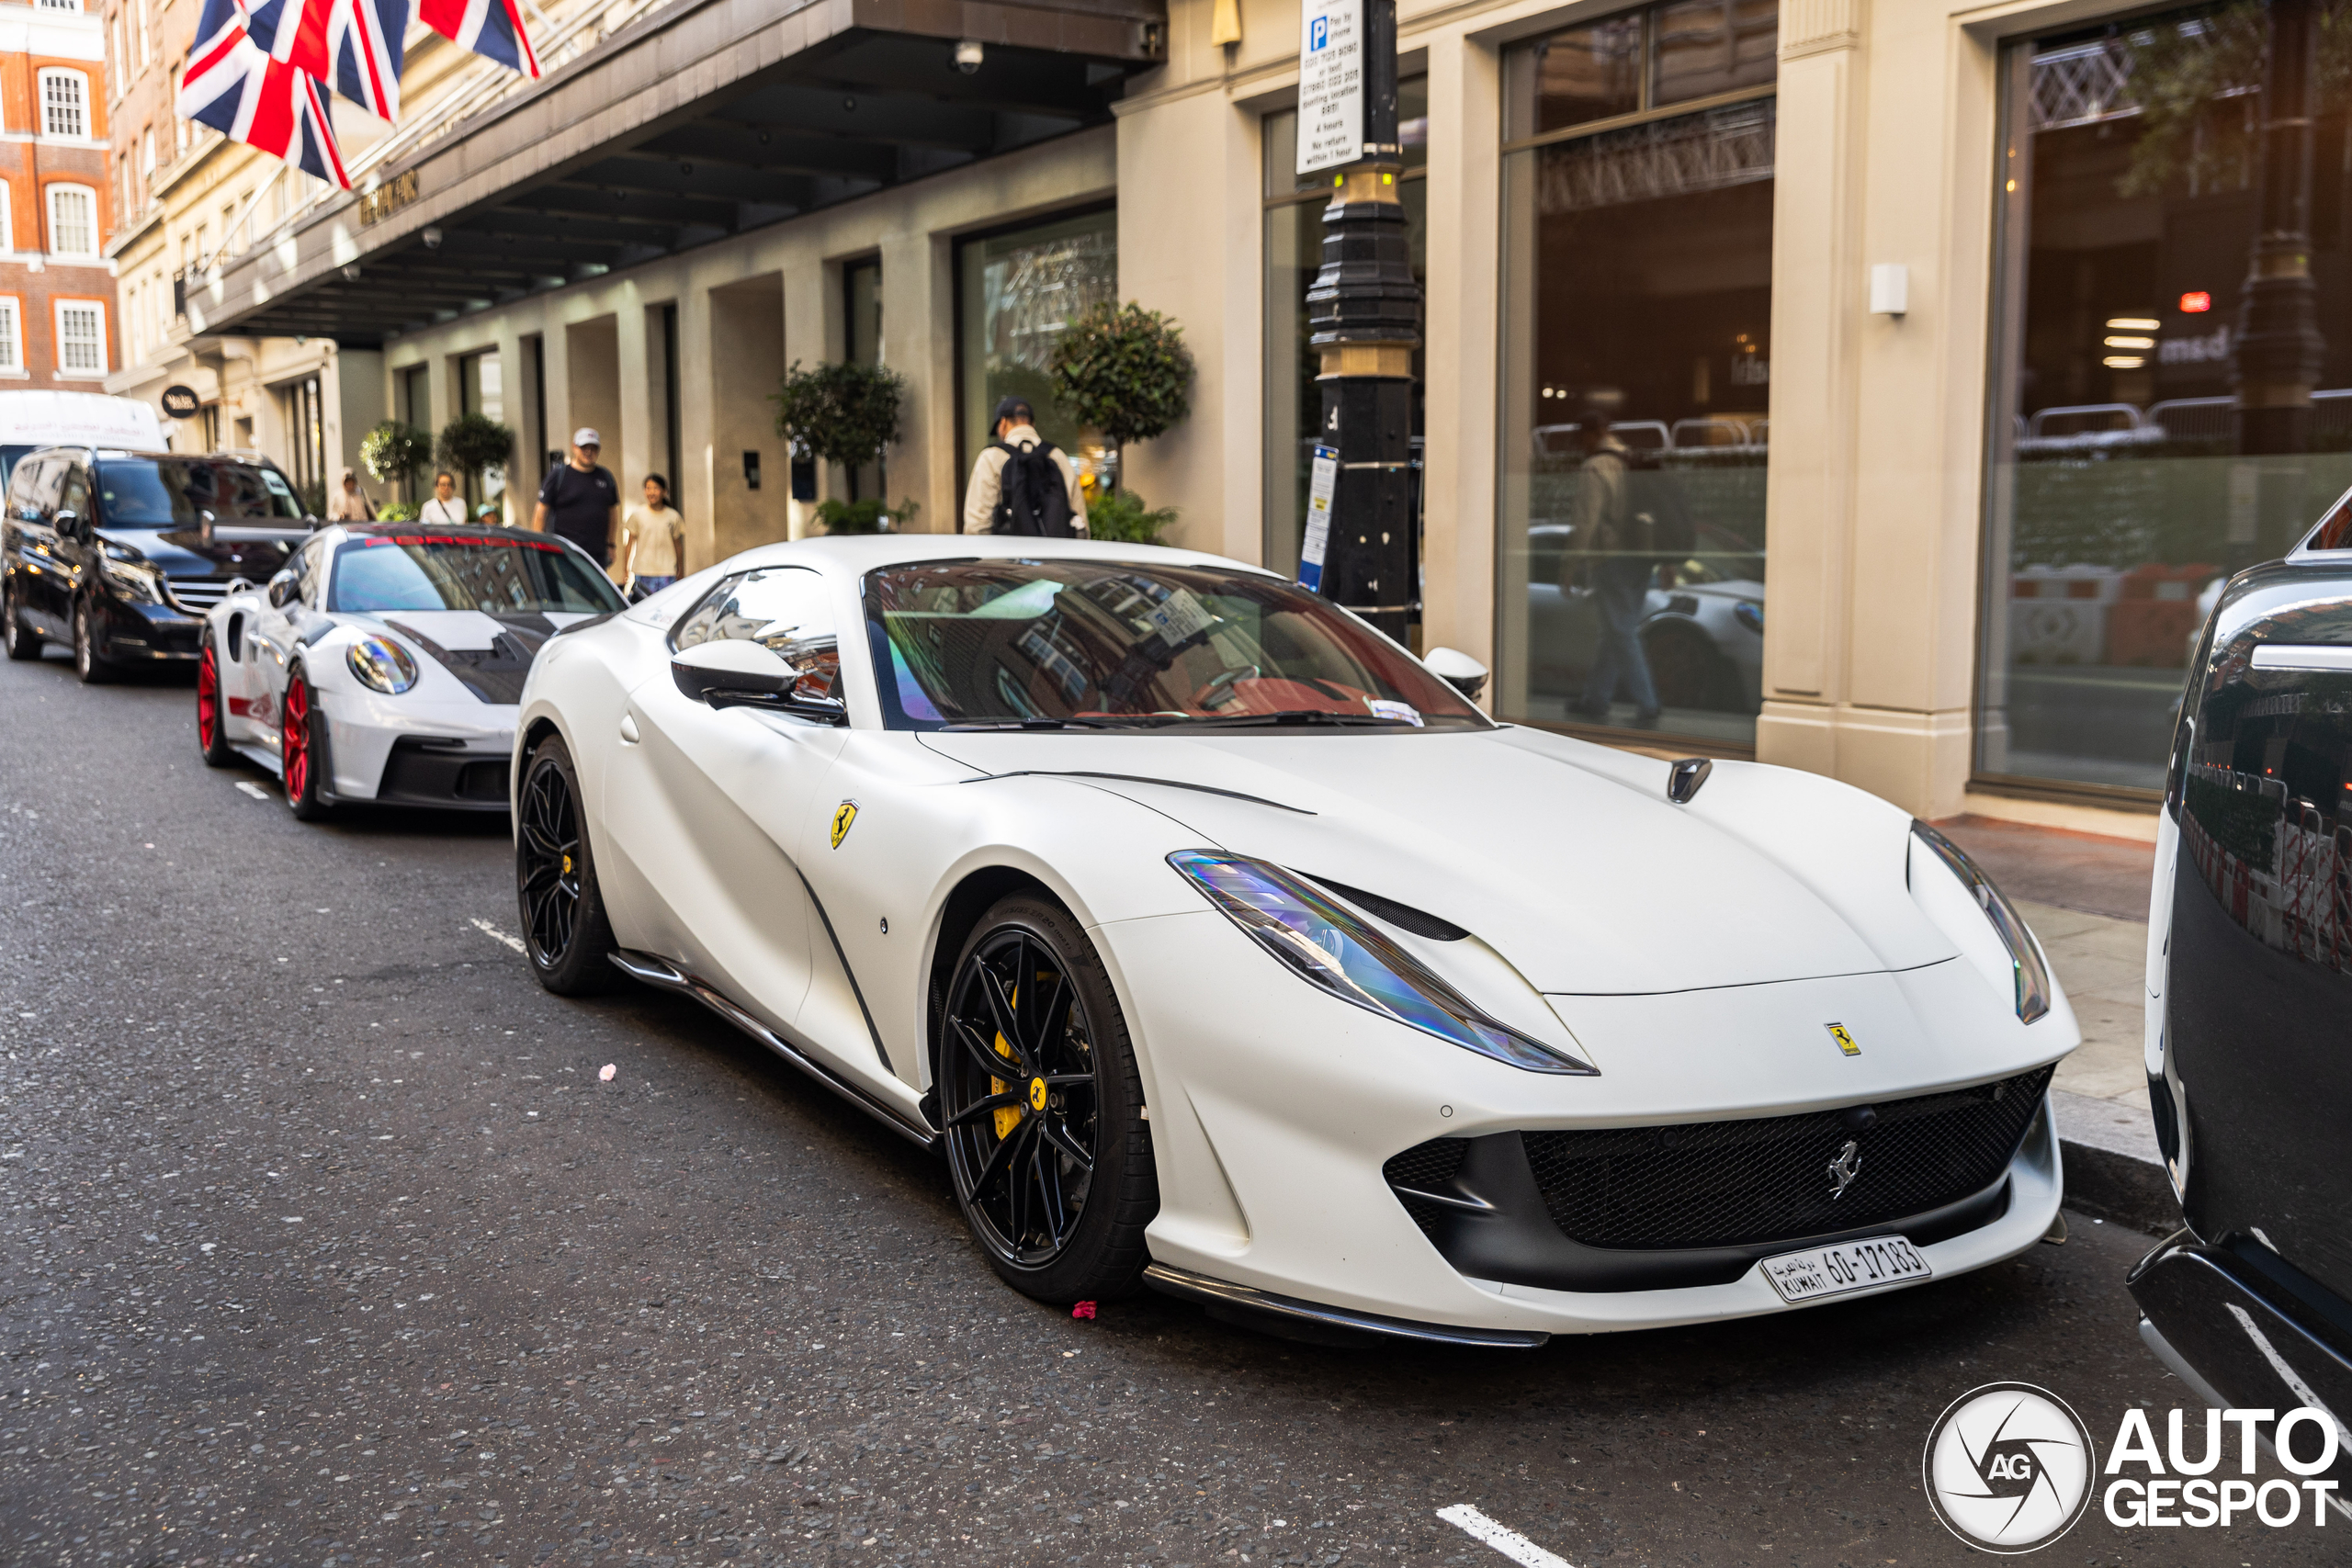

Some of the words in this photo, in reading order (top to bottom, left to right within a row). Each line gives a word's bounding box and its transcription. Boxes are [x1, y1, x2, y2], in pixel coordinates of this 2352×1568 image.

[1330, 16, 1340, 28] Pay
[1344, 12, 1352, 24] by
[1314, 18, 1326, 51] P
[1330, 27, 1351, 41] phone
[1318, 69, 1326, 78] or
[1328, 62, 1342, 74] text
[1303, 94, 1328, 109] quoting
[1330, 85, 1359, 99] location
[1324, 118, 1343, 131] hours
[1312, 139, 1322, 151] No
[1324, 134, 1347, 148] return
[1306, 153, 1328, 165] within
[1336, 146, 1352, 160] hour
[1030, 909, 1055, 928] ZR20
[1773, 1261, 1800, 1278] الكويت
[1781, 1273, 1827, 1294] KUWAIT
[1824, 1241, 1921, 1284] 60-17183
[1794, 1258, 1816, 1272] دولة
